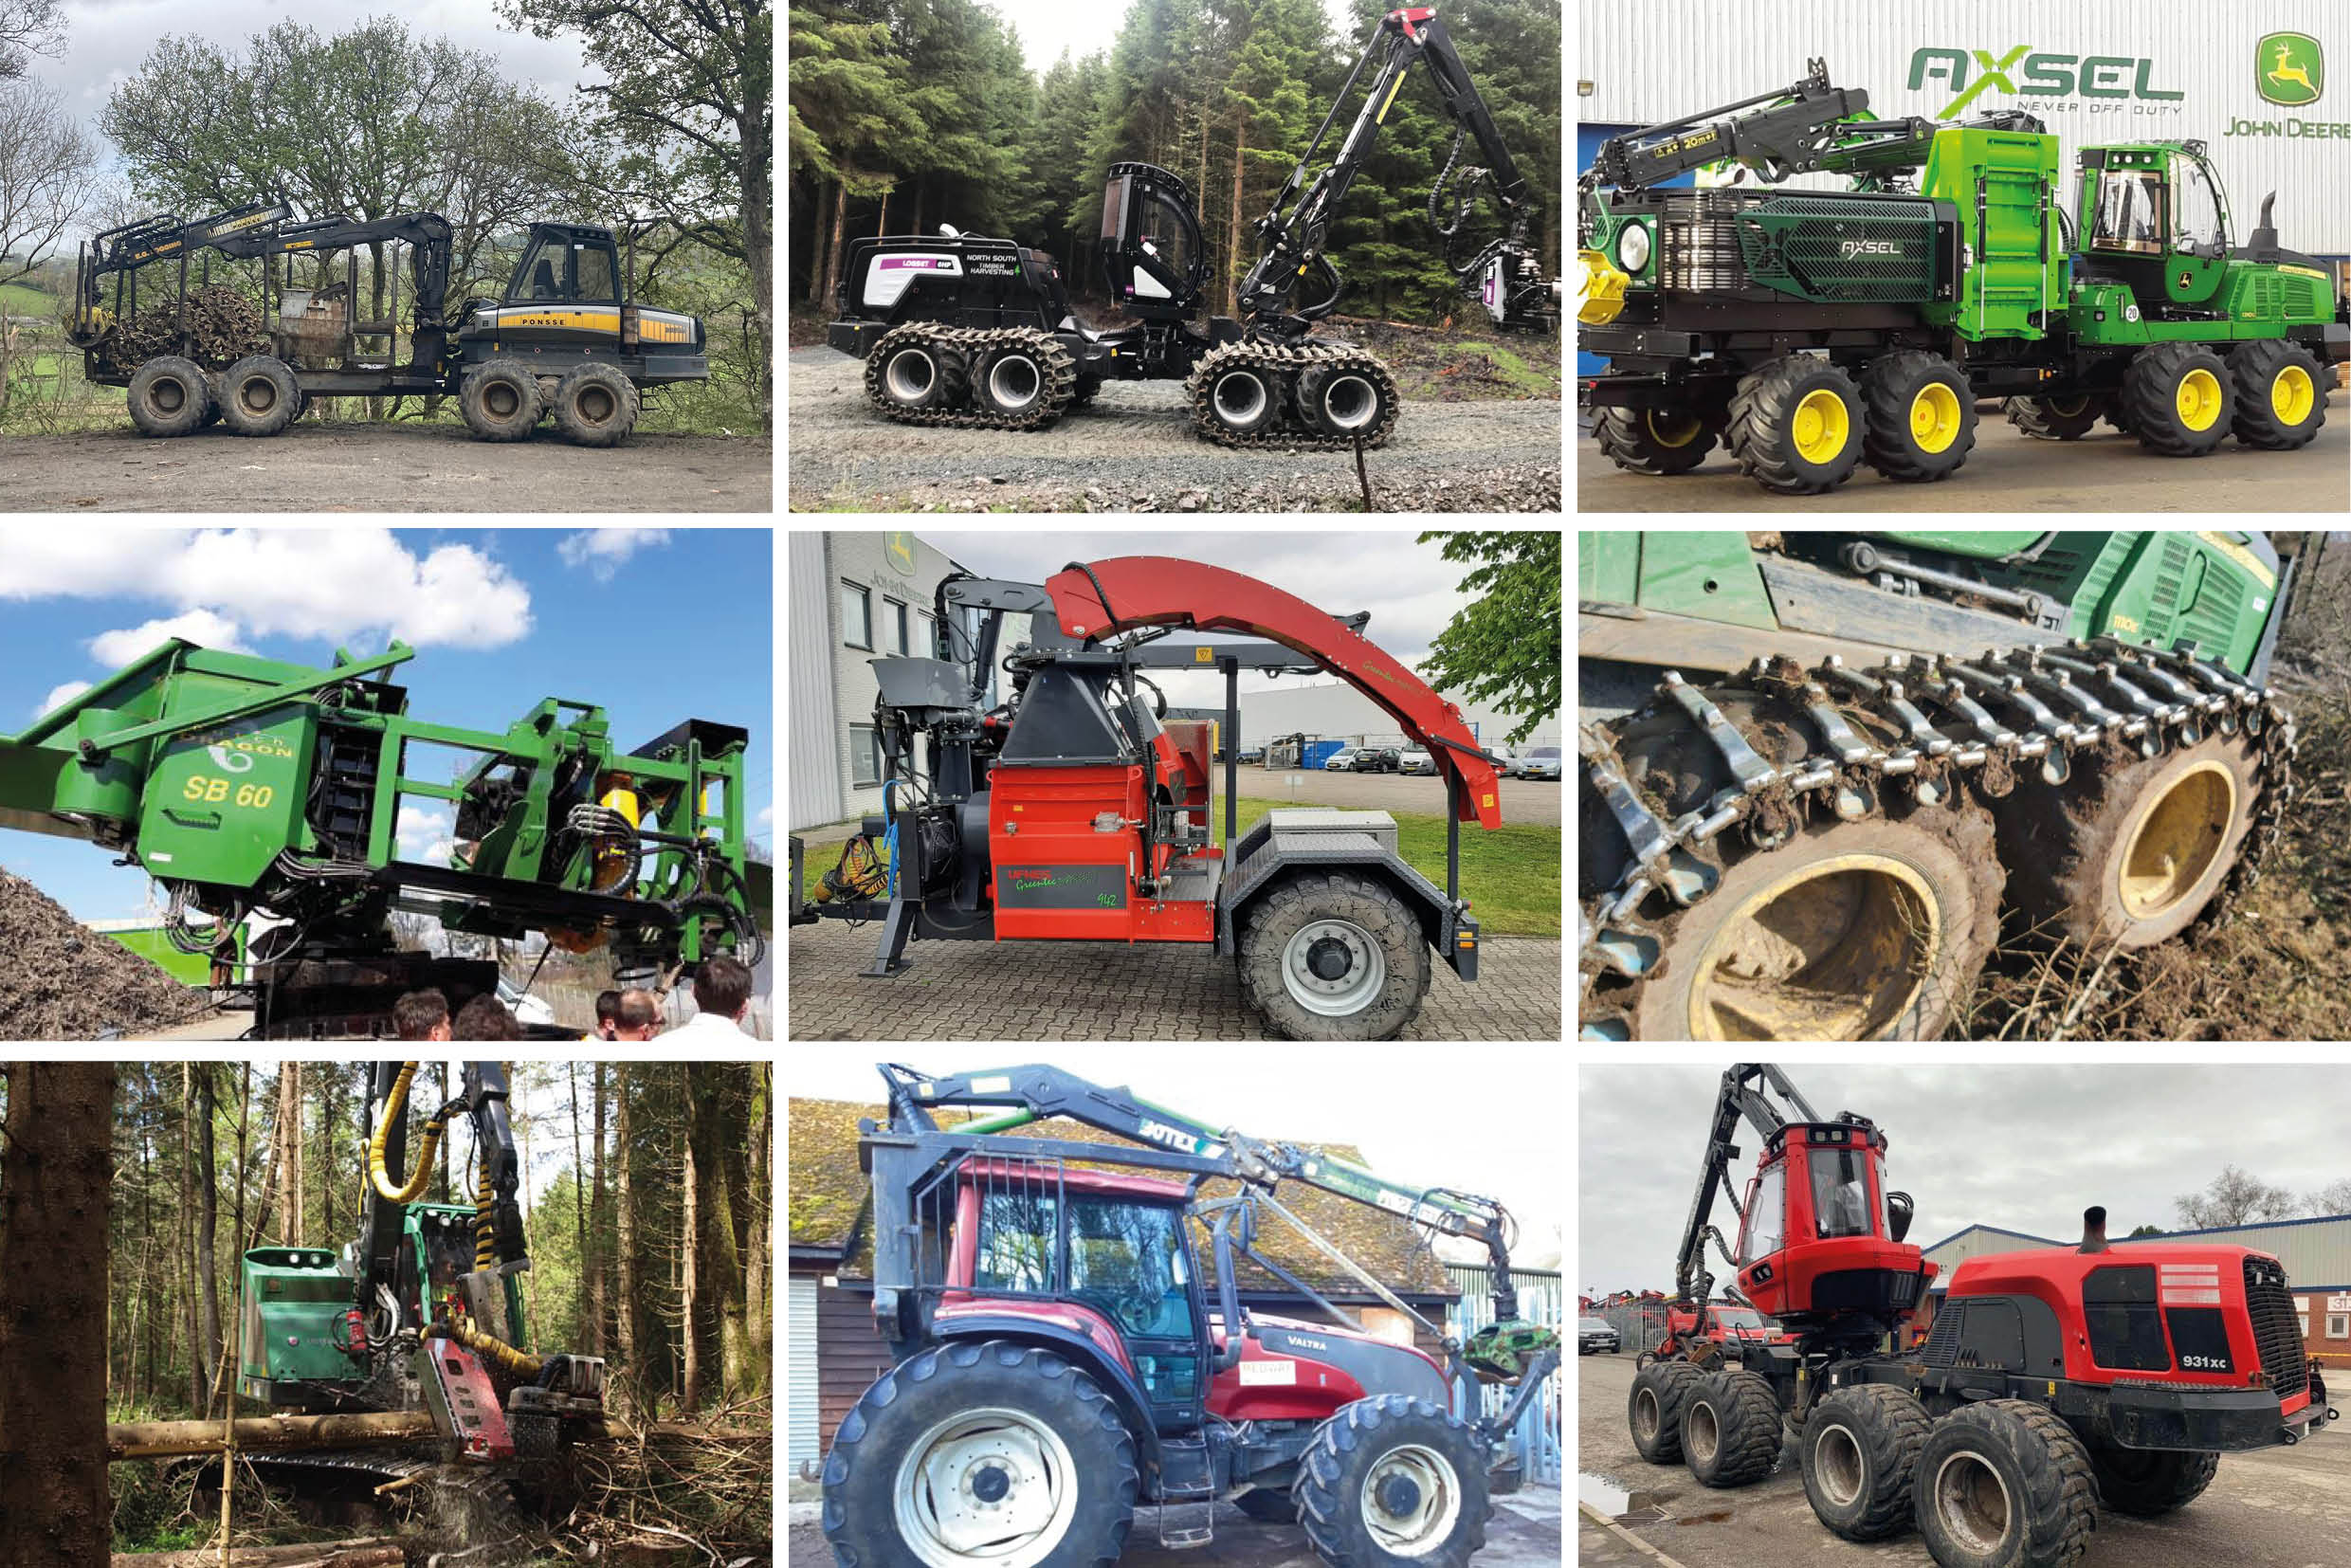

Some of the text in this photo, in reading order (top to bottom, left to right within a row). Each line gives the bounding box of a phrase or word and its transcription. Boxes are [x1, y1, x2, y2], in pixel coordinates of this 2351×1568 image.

[1907, 45, 2184, 119] AXSEL
[2017, 100, 2182, 115] NEVER OFF DUTY
[2223, 116, 2351, 139] JOHN DEERE
[1841, 239, 1901, 261] AXSEL
[2127, 308, 2137, 319] 20
[183, 775, 273, 809] SB 60
[1097, 893, 1117, 906] 942
[1287, 1335, 1327, 1351] VALTRA
